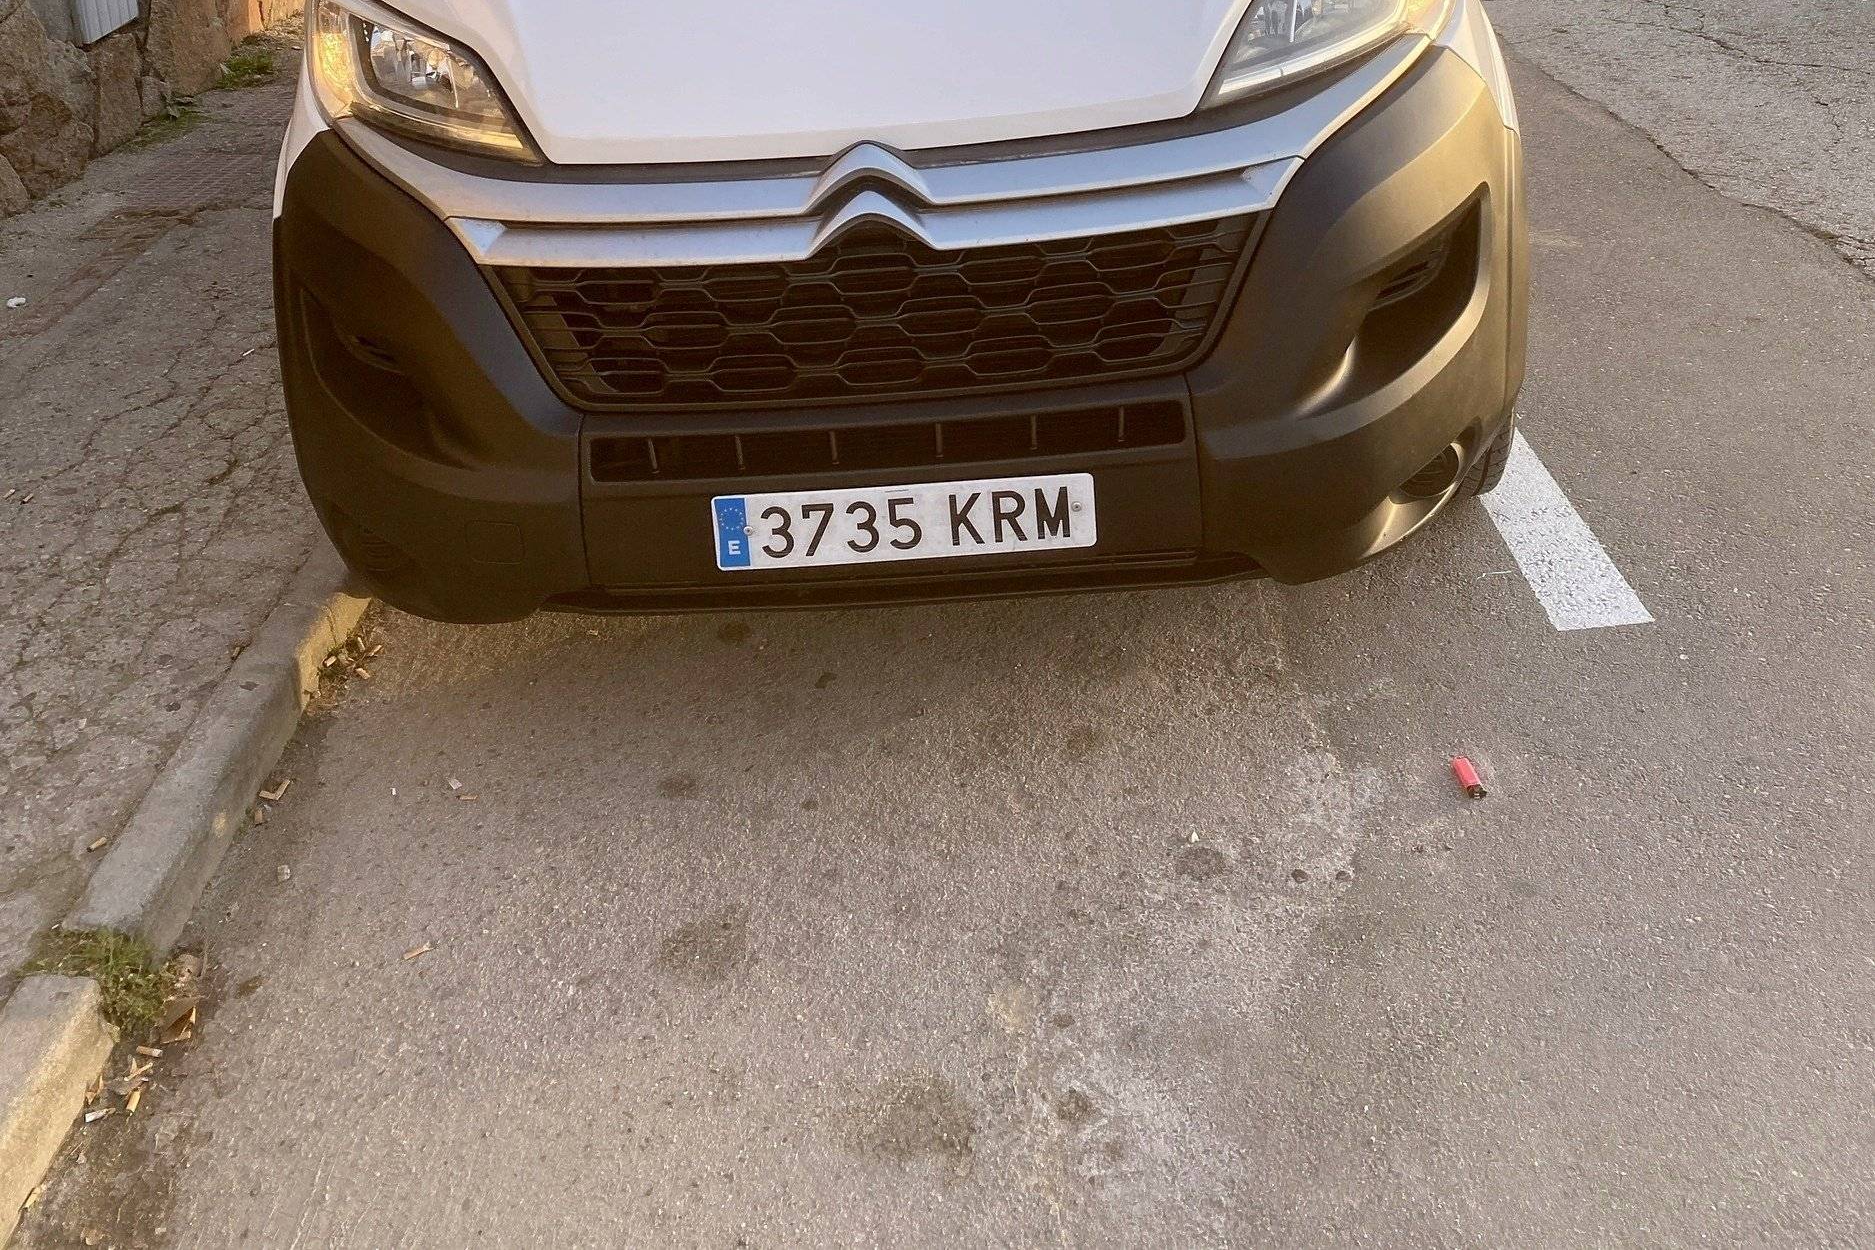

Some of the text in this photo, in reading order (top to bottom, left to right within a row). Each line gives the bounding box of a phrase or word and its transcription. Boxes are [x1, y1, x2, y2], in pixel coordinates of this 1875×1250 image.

[760, 486, 1072, 558] 3735 KRM
[728, 540, 741, 555] E
